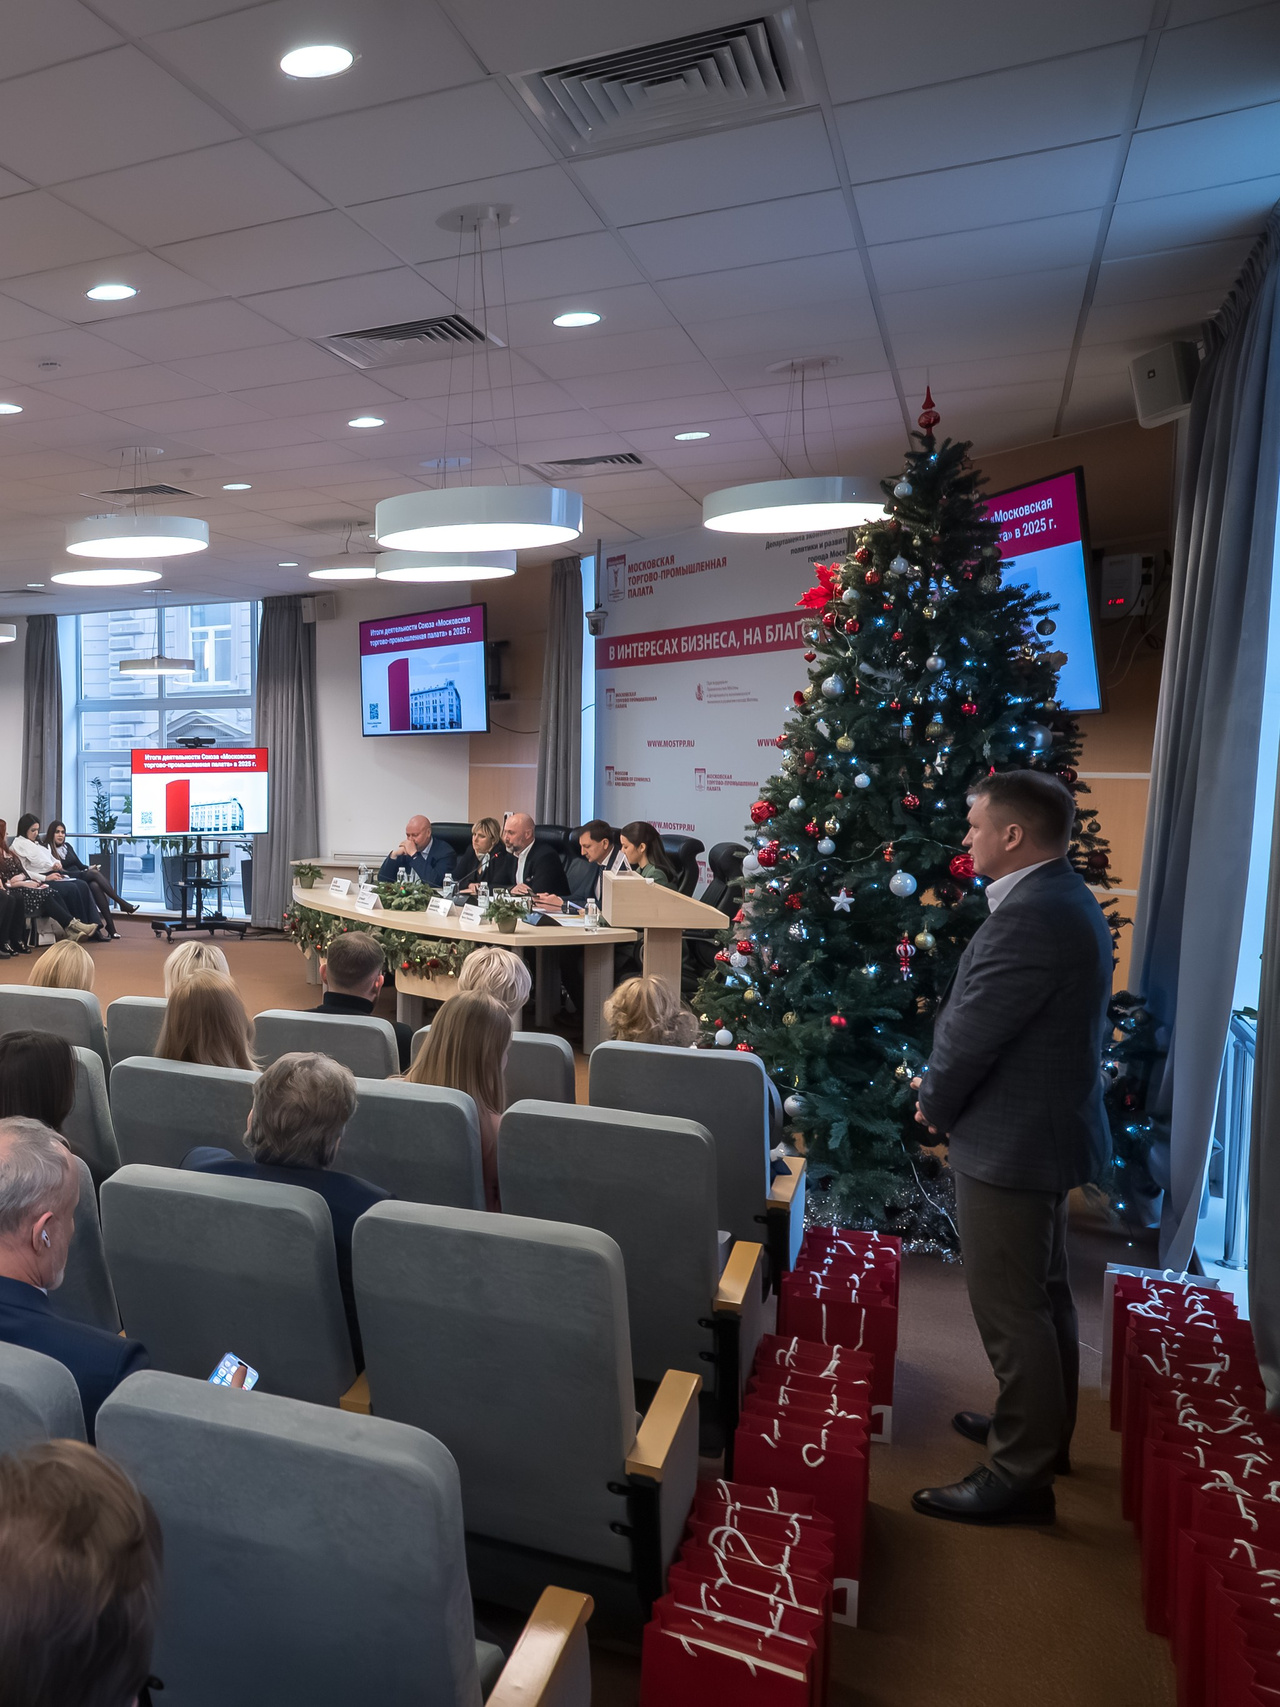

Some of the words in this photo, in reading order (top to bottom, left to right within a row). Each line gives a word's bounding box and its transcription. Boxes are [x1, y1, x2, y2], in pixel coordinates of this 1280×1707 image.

[990, 497, 1053, 523] «Московская
[1014, 528, 1021, 539] в
[1022, 517, 1047, 536] 2025
[1049, 518, 1057, 529] г.
[790, 544, 818, 555] политики
[807, 553, 829, 563] города
[829, 549, 846, 559] Моск
[627, 555, 675, 574] МОСКОВСКАЯ
[627, 556, 727, 586] ТОРГОВО-ПРОМЫШЛЕННАЯ
[627, 585, 654, 599] ПАЛАТА
[453, 627, 467, 636] 2025
[609, 645, 616, 661] В
[617, 637, 679, 660] ИНТЕРЕСАХ
[681, 630, 740, 654] БИЗНЕСА,
[743, 625, 763, 645] НА
[647, 739, 695, 748] WWW.MOSTPP.RU
[648, 820, 695, 832] WW.MOSTPP.RU
